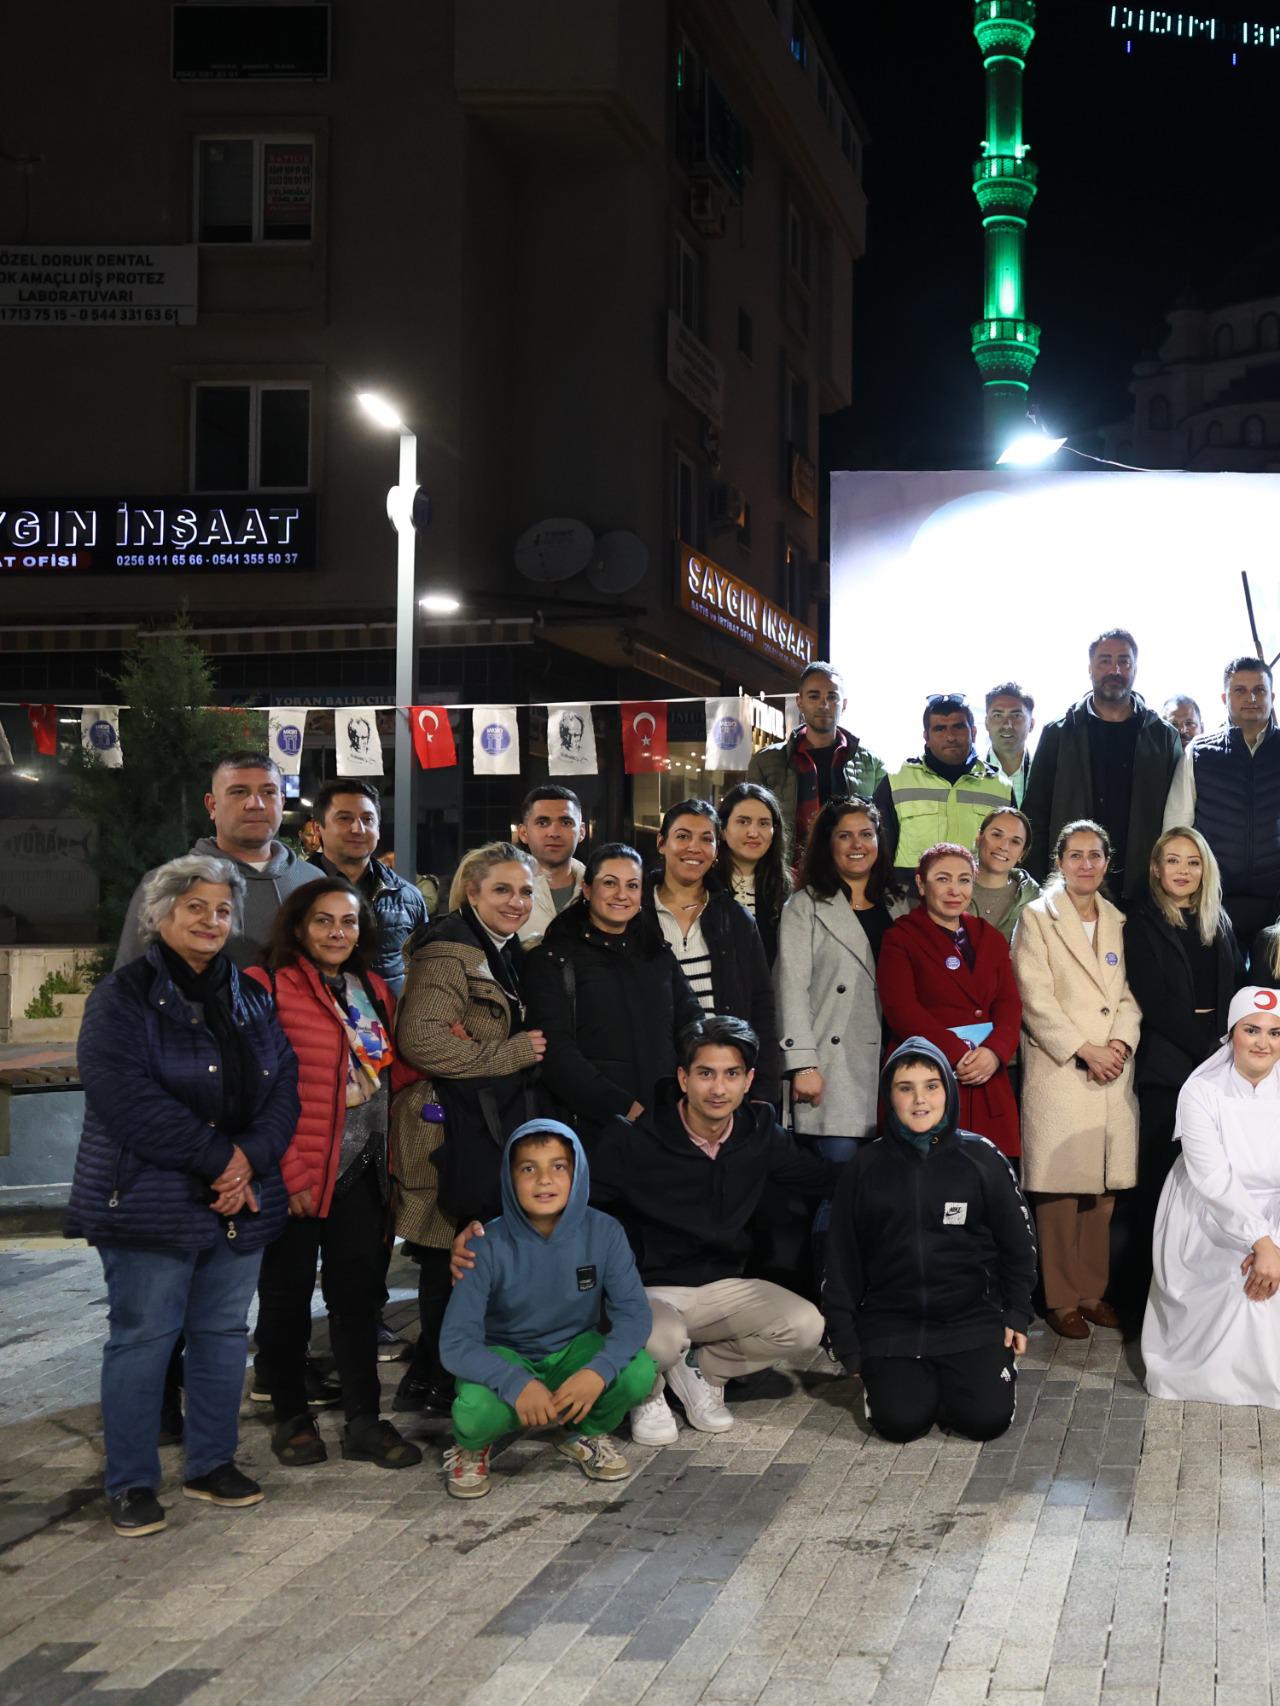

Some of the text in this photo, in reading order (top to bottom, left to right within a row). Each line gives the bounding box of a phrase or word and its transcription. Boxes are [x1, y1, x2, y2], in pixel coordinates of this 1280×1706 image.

[41, 253, 93, 267] DORUK
[96, 253, 154, 267] DENTAL
[106, 272, 165, 285] PROTEZ
[19, 290, 133, 303] LABORATUVARI
[0, 501, 299, 550] GIN İNŞAAT
[22, 553, 78, 567] OFİSİ
[116, 554, 145, 566] 0256
[148, 554, 168, 566] 811
[172, 554, 186, 566] 65
[189, 554, 203, 566] 66
[212, 553, 240, 566] 0541
[243, 553, 265, 565] 355
[267, 553, 282, 565] 50
[284, 553, 299, 564] 37
[688, 556, 758, 631] SAYGIN
[275, 696, 322, 707] YORAN
